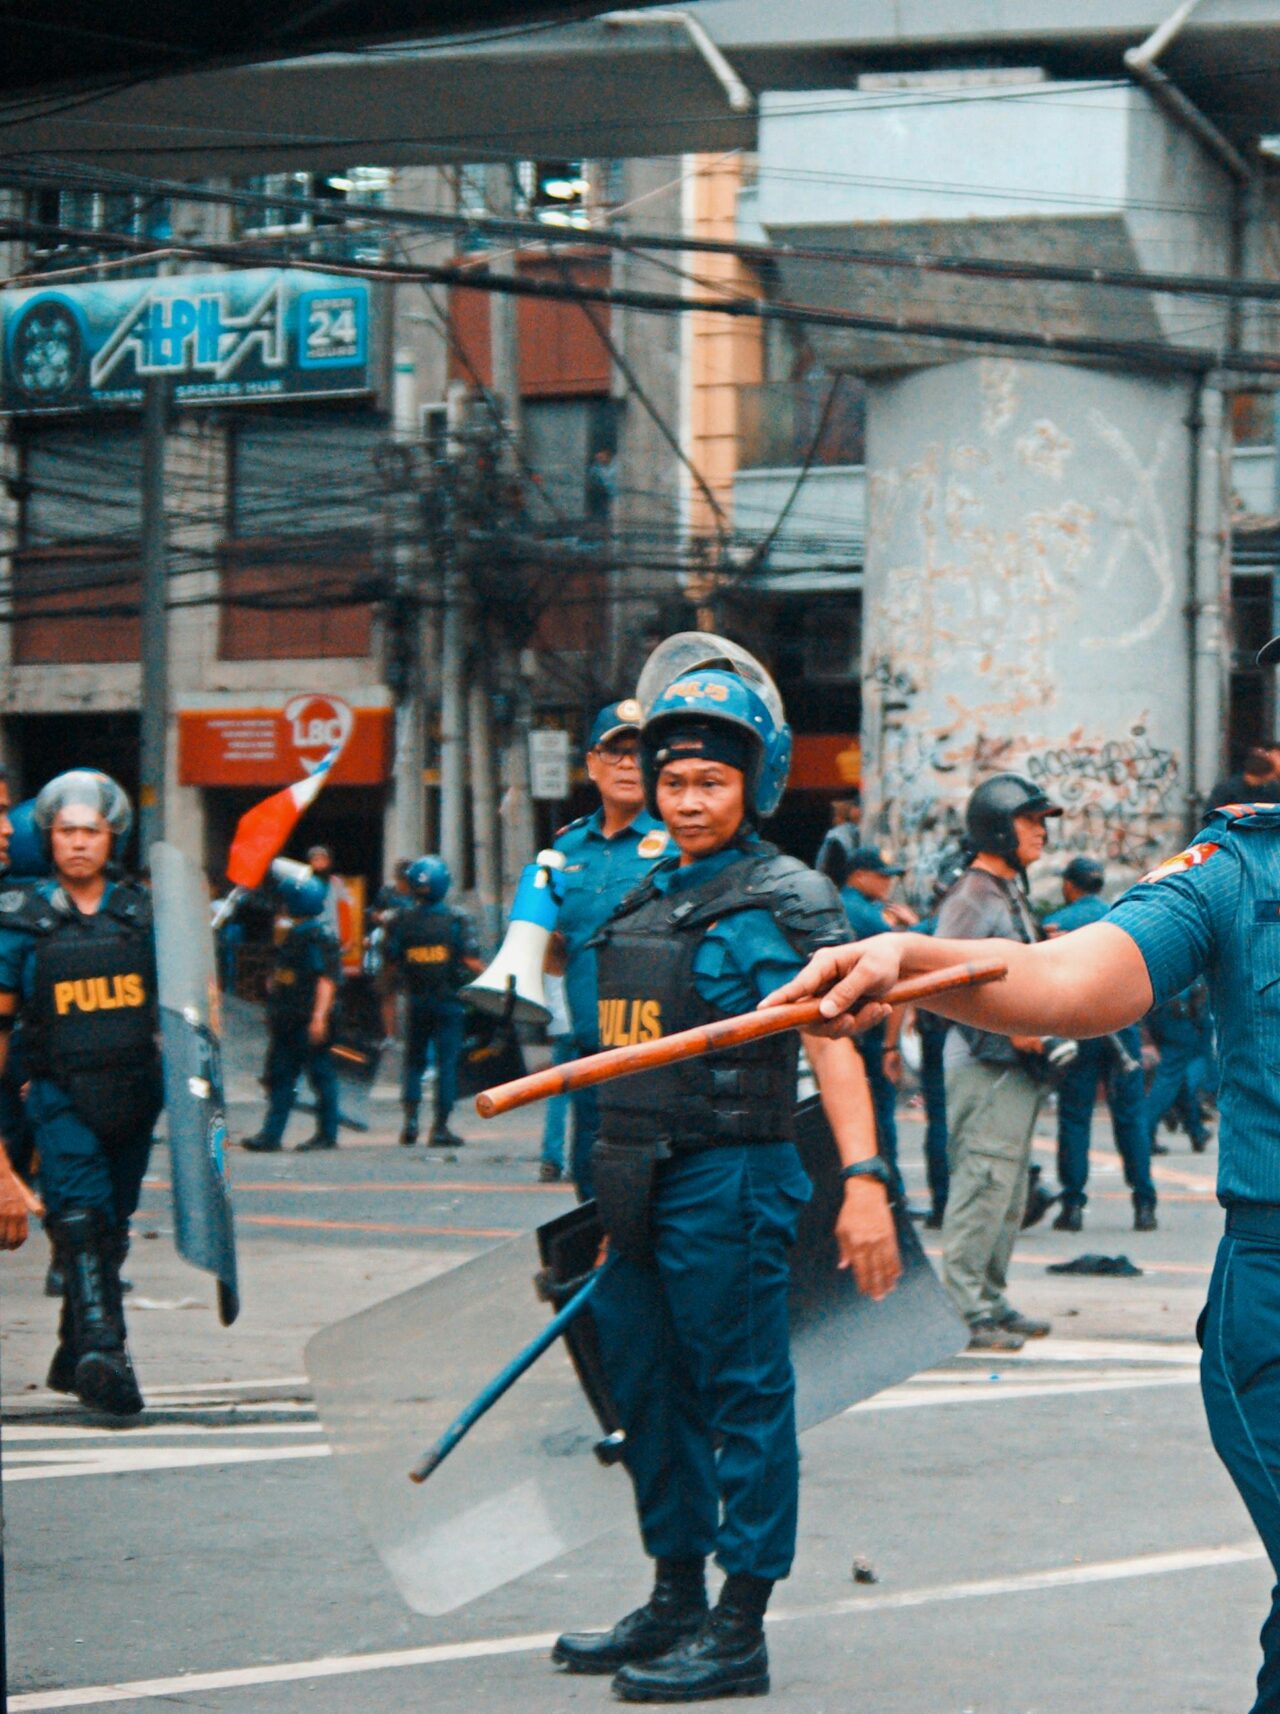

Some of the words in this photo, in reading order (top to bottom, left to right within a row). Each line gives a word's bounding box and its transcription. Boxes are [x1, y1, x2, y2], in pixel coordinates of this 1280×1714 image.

[307, 310, 357, 346] 24
[176, 383, 241, 397] SPORTS
[245, 380, 282, 393] HUB
[54, 972, 147, 1016] PULIS
[598, 998, 662, 1046] ULIS
